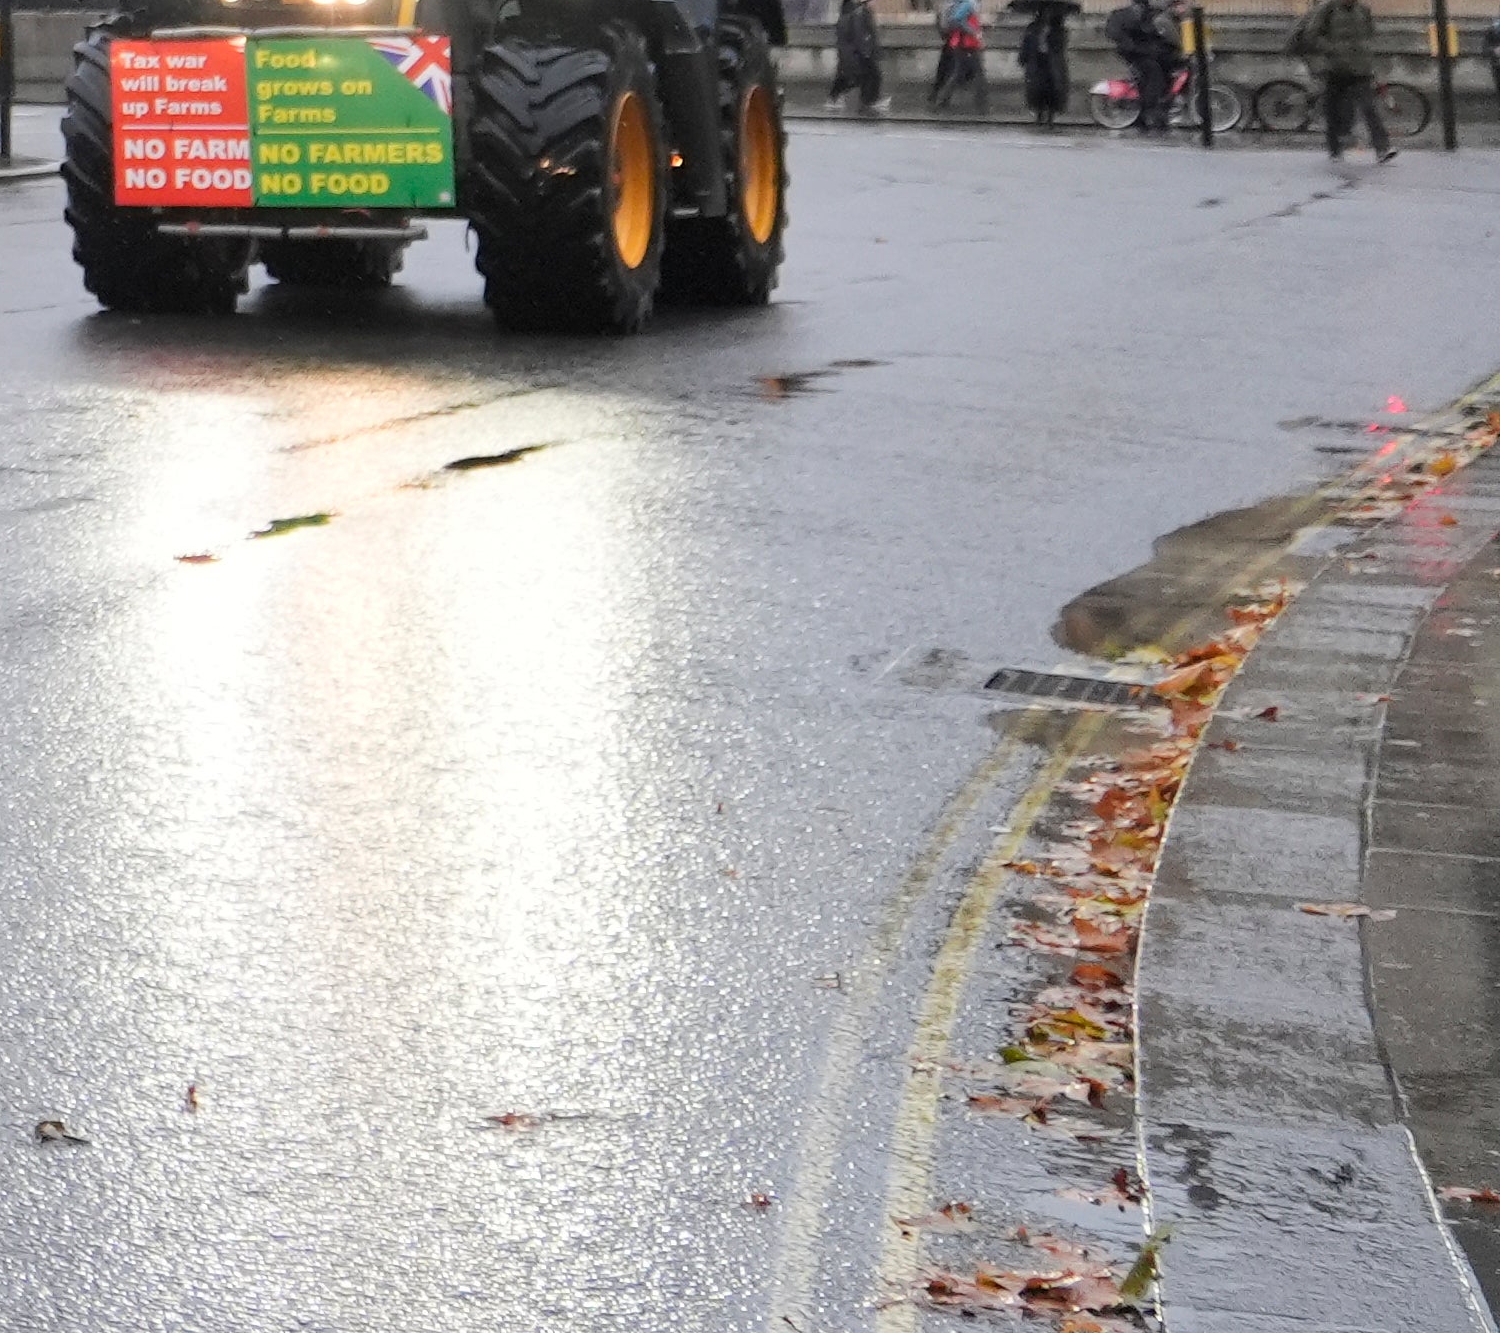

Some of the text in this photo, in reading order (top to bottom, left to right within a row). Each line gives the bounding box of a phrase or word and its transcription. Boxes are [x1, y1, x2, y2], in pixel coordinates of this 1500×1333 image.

[120, 51, 207, 71] Tax war
[255, 49, 317, 70] Food
[121, 75, 228, 93] will break
[257, 80, 373, 101] grows on
[122, 98, 223, 117] up Farms
[258, 105, 337, 125] Farms
[124, 139, 165, 161] NO
[259, 142, 444, 165] NO FARMERS
[125, 168, 252, 190] NO FOOD
[261, 173, 390, 195] NO FOOD
